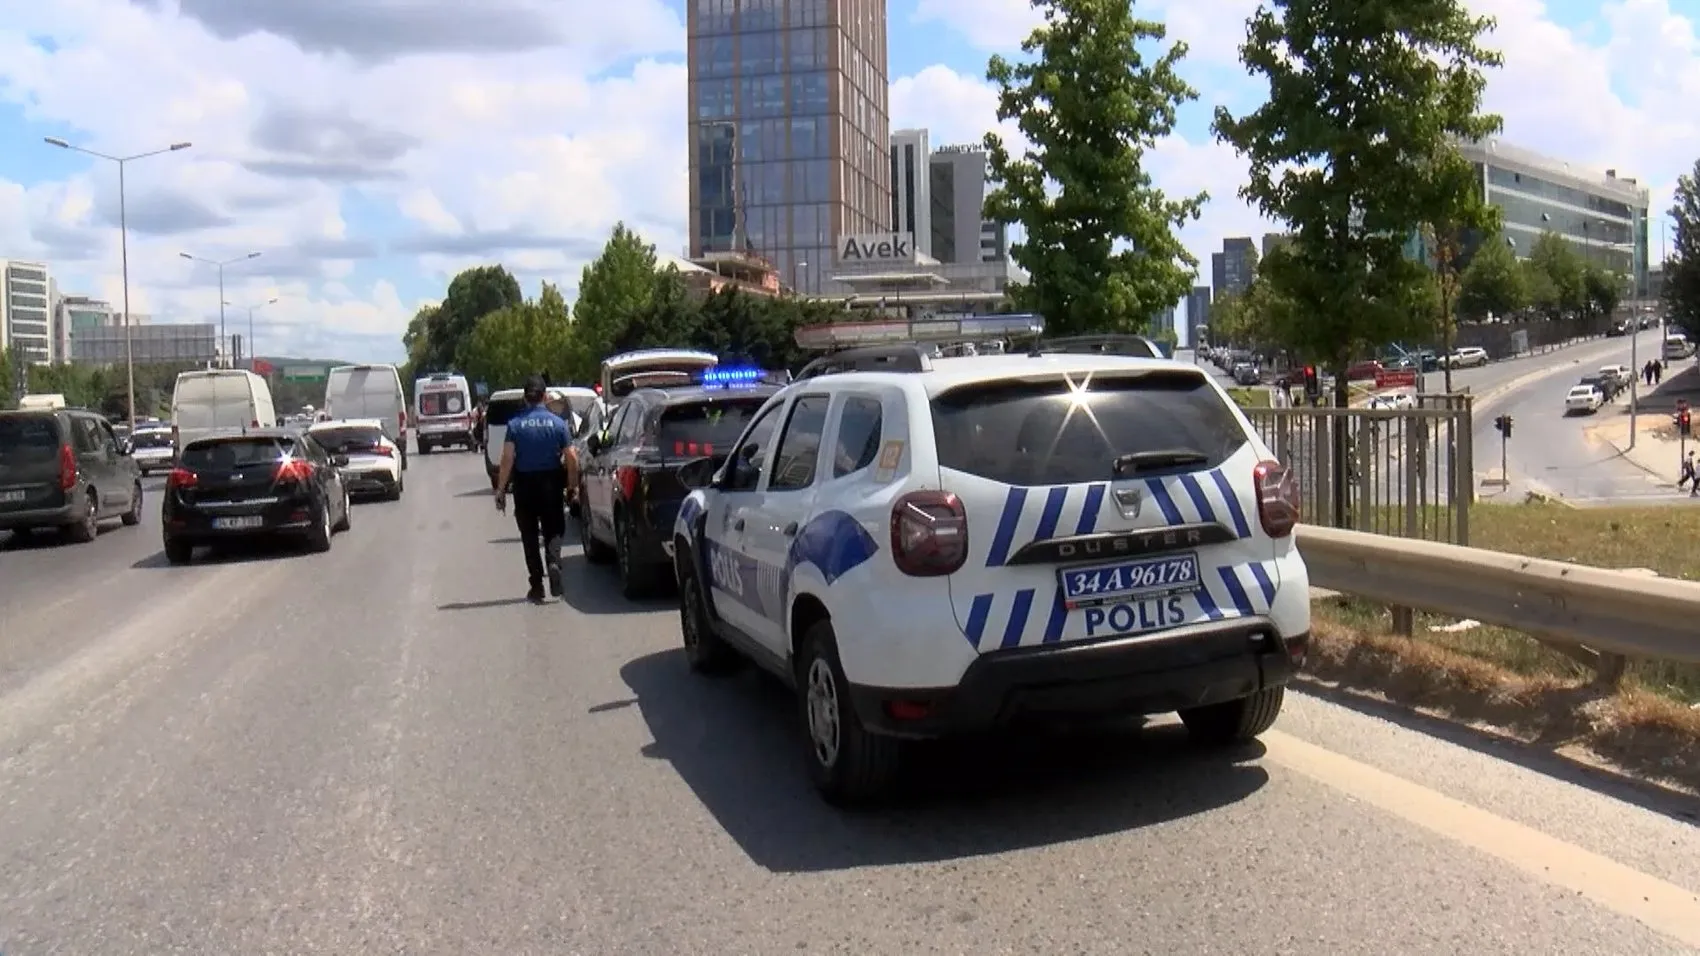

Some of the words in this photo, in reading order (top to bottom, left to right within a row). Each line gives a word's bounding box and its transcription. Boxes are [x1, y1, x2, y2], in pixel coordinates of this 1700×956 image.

[843, 236, 908, 260] Avek
[1058, 529, 1201, 556] DUSTER
[1071, 572, 1101, 596] 34
[1105, 567, 1124, 591] A
[1130, 559, 1193, 588] 96178
